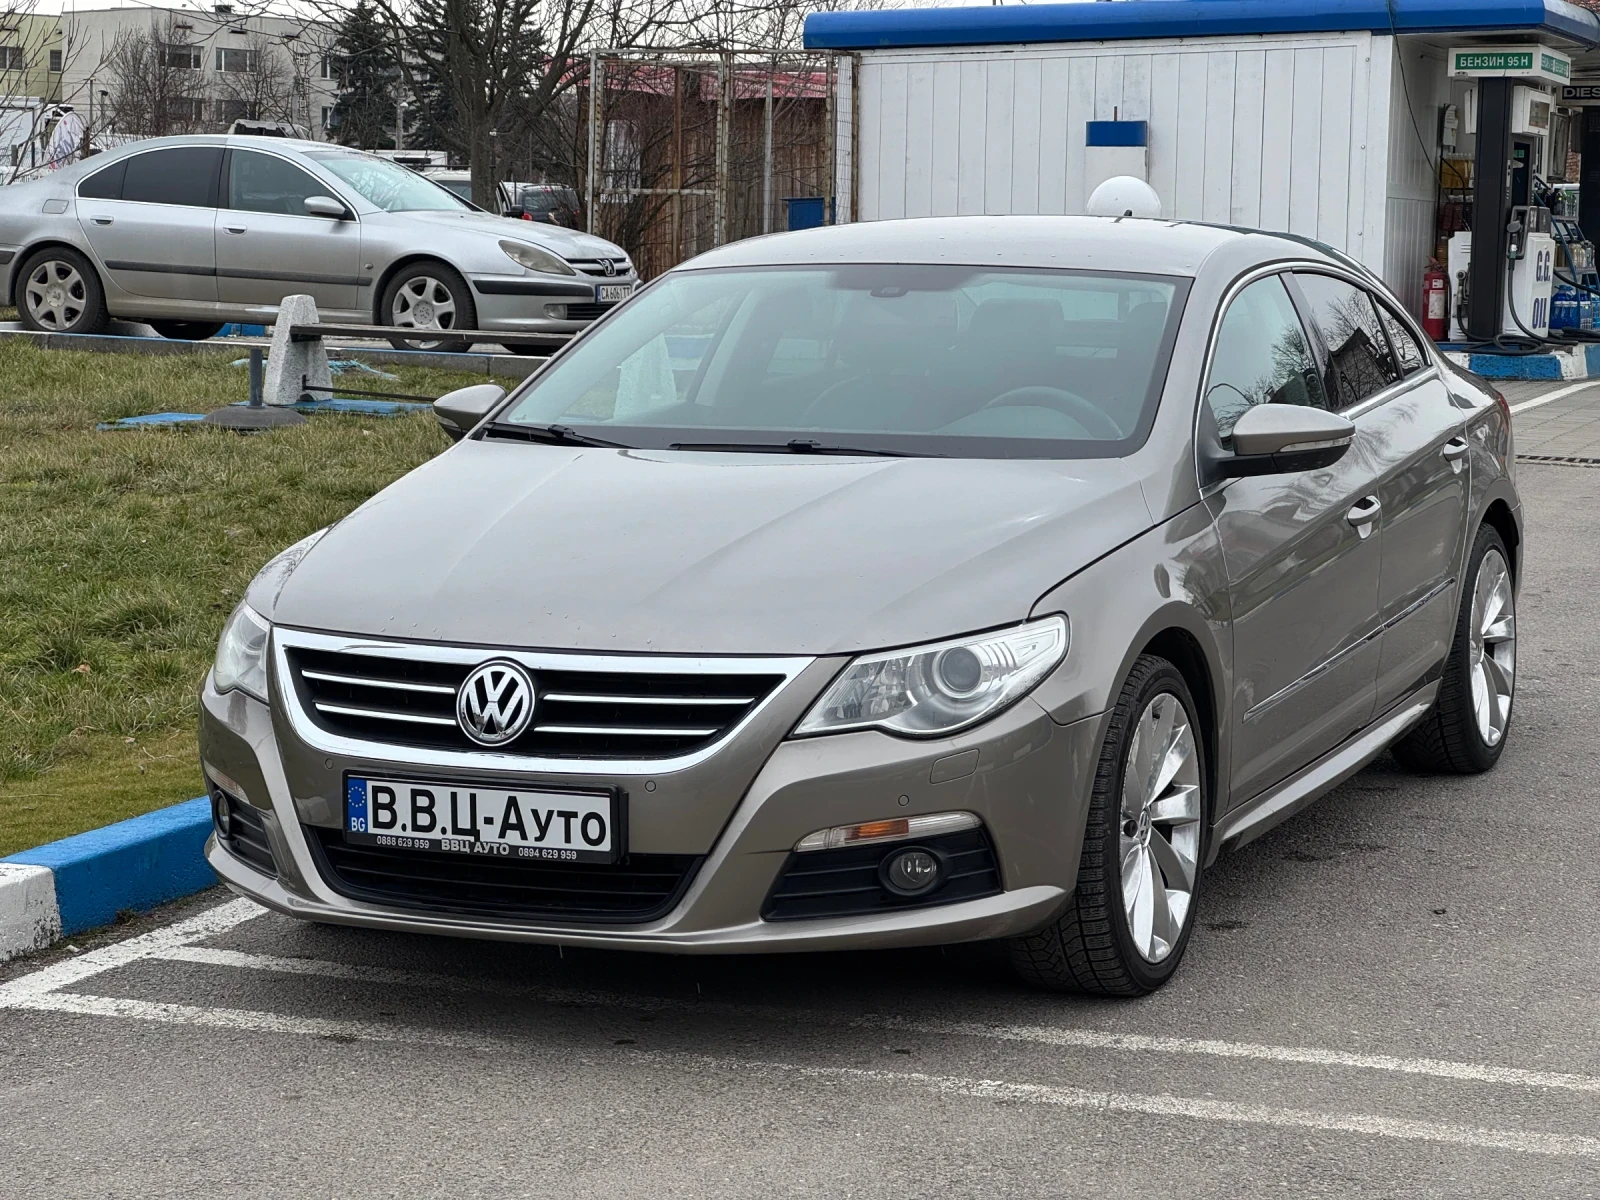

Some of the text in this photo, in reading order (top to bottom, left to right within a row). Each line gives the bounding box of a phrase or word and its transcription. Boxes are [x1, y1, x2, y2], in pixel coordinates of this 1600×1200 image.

[1460, 56, 1504, 67] БЕНЗИН
[1532, 298, 1547, 329] OIL
[351, 817, 365, 831] BG
[377, 836, 577, 860] 0888 629 959 ВВЦ АУТО 0894 629 959
